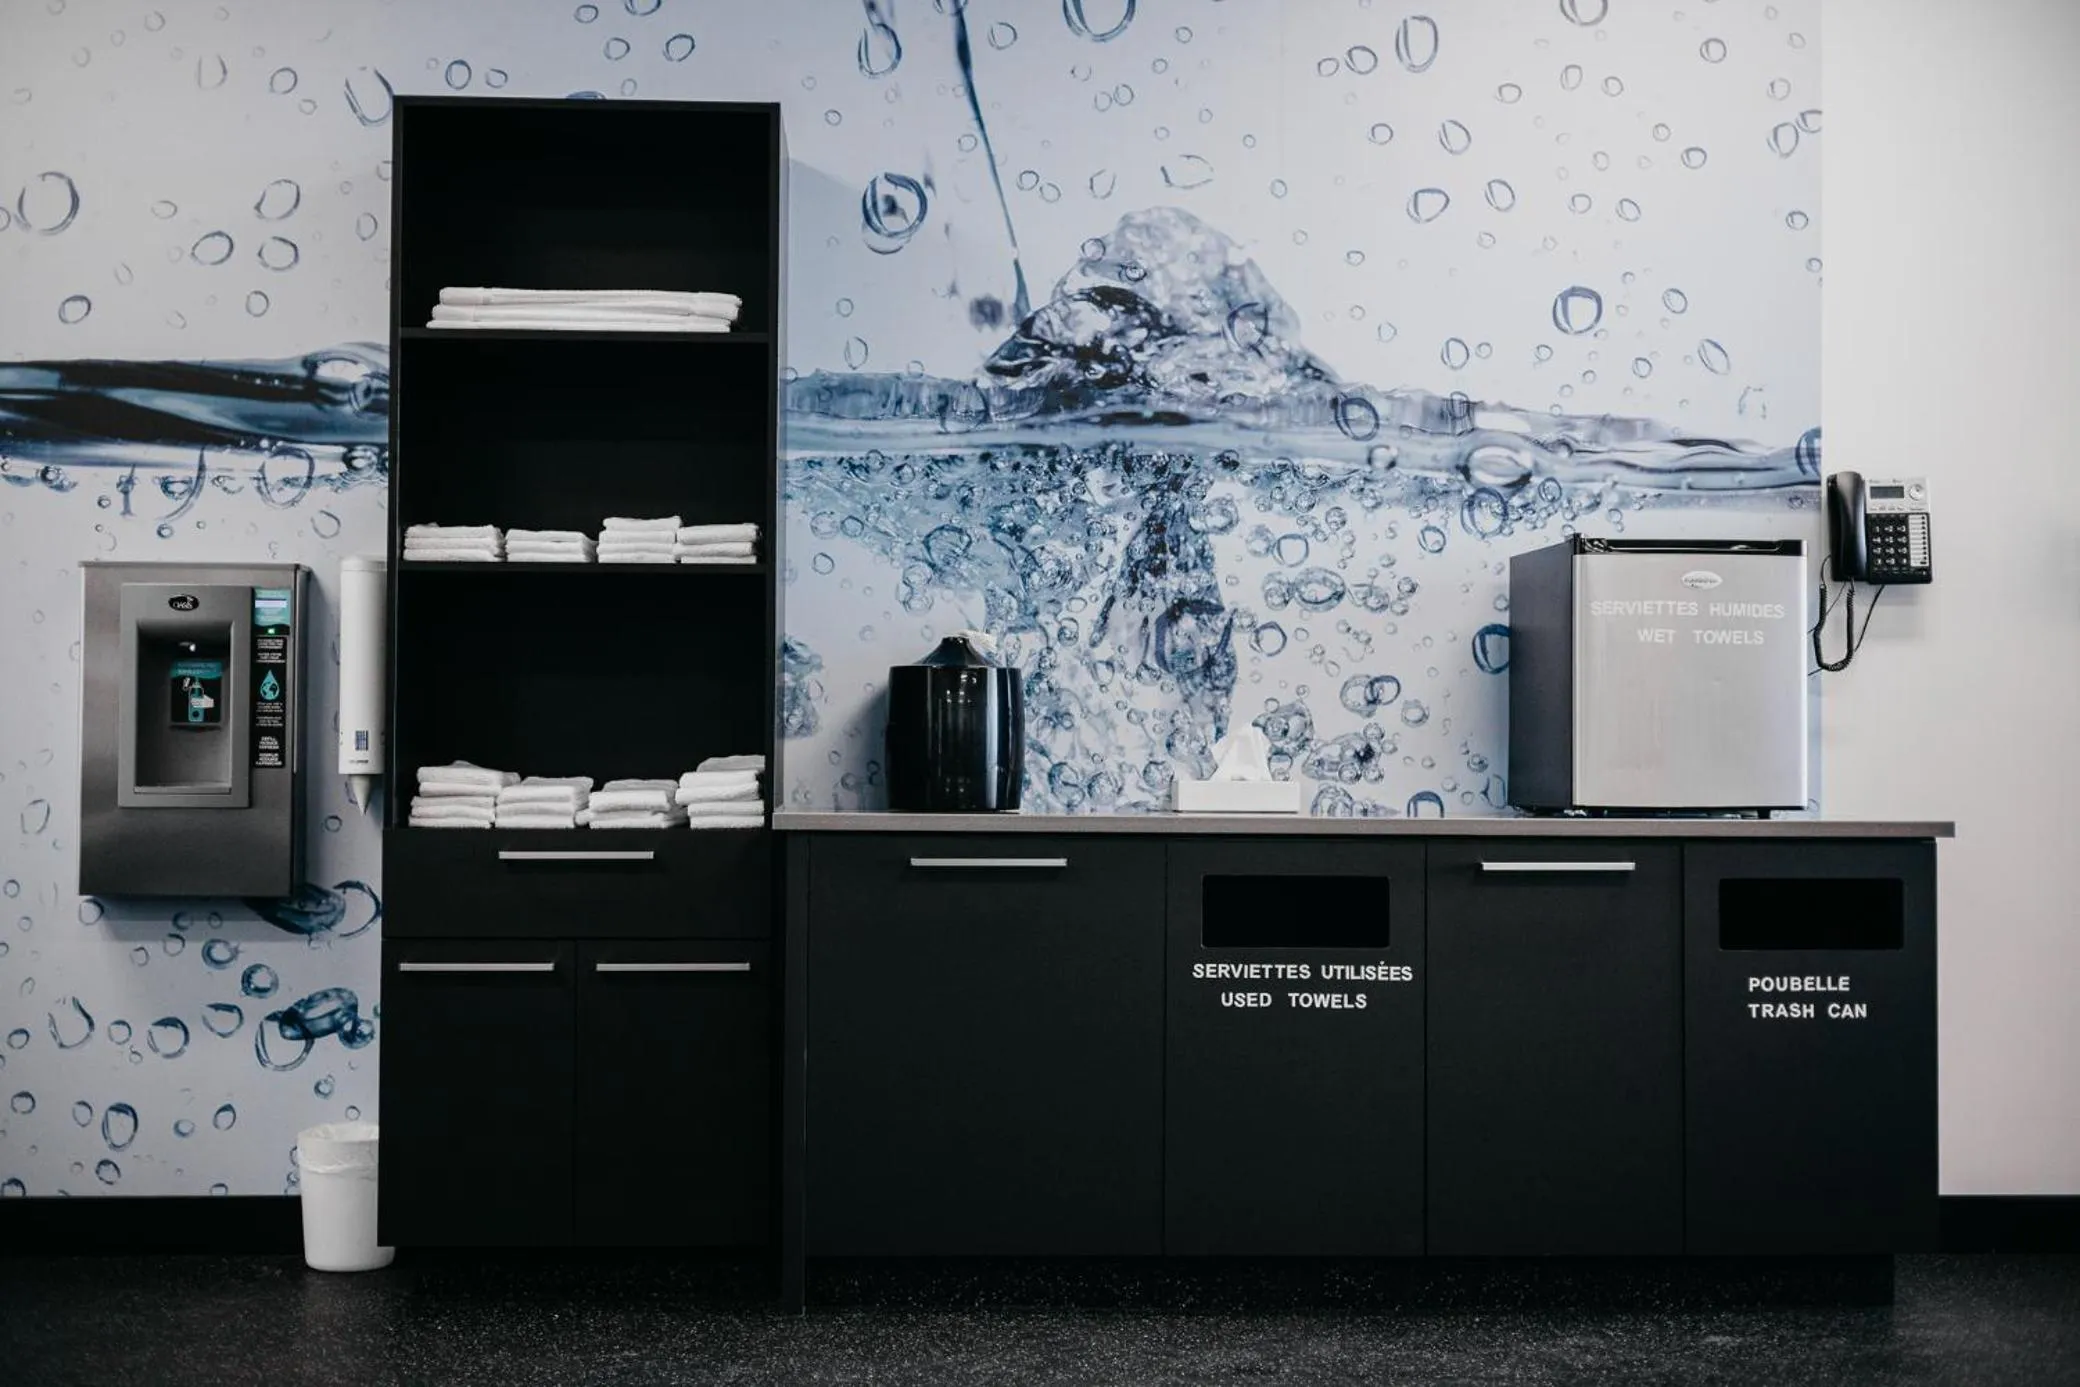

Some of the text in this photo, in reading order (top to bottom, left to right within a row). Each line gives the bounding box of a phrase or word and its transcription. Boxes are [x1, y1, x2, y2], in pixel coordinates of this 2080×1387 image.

[1589, 600, 1786, 619] SERVIETTES HUMIDES
[1637, 628, 1765, 645] WET TOWELS
[1191, 961, 1414, 982] SERVIETTES UTILISÉES
[1748, 975, 1851, 993] POUBELLE
[1220, 991, 1368, 1009] USED TOWELS
[1747, 1002, 1868, 1019] TRASH CAN
